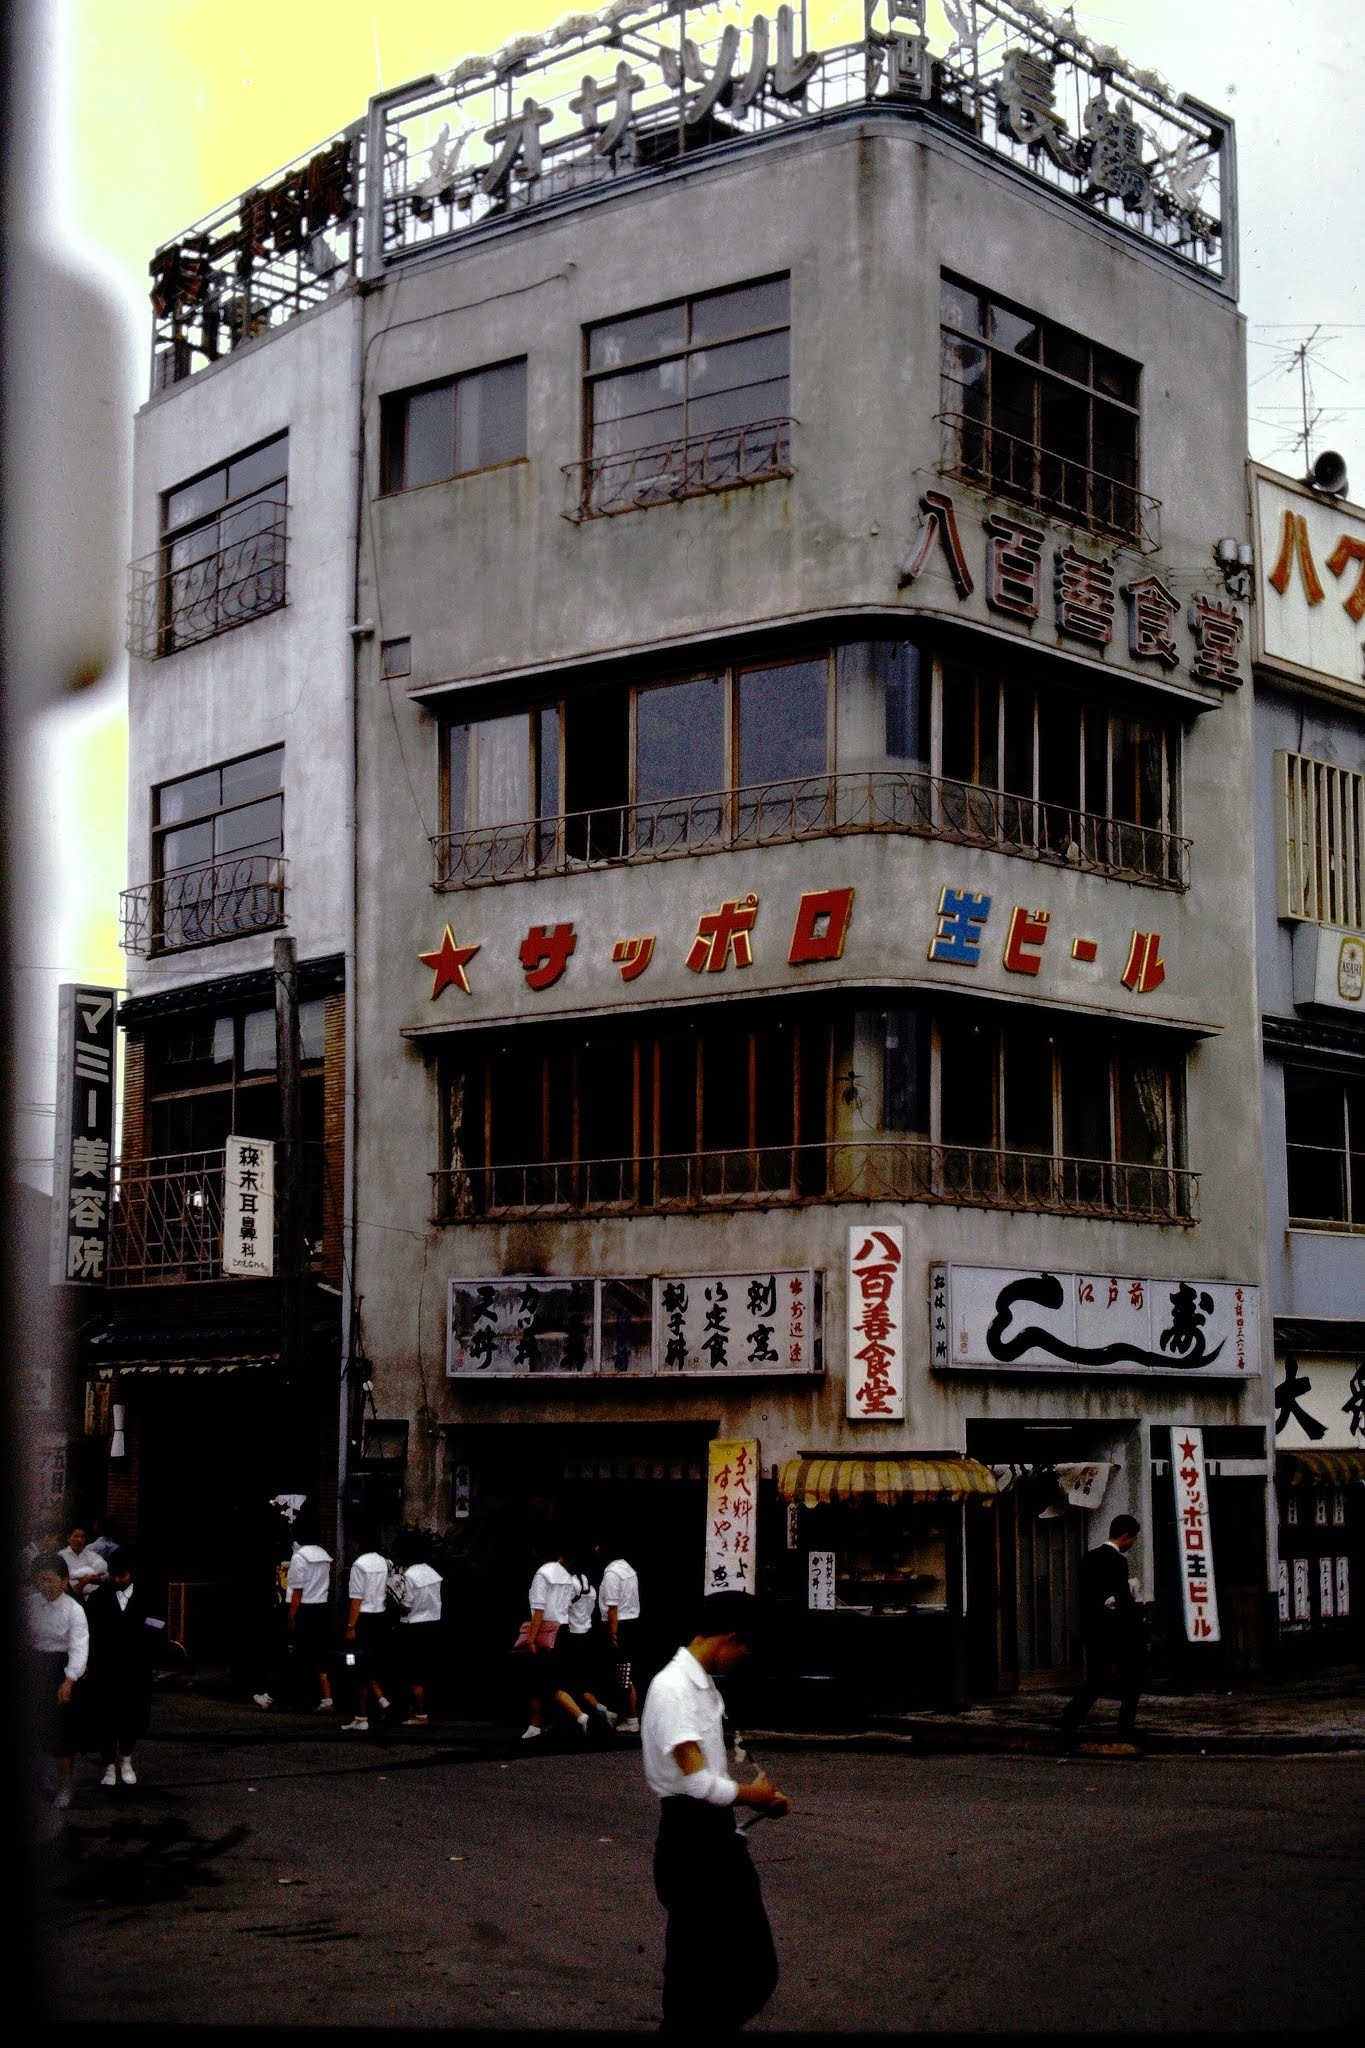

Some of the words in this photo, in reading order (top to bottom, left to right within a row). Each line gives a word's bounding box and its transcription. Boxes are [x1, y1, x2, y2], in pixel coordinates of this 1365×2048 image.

[898, 490, 1244, 690] 八百善食堂
[67, 993, 112, 1278] マミー美容院
[852, 1231, 901, 1415] 八百善食堂
[1078, 1278, 1144, 1311] 江戸前
